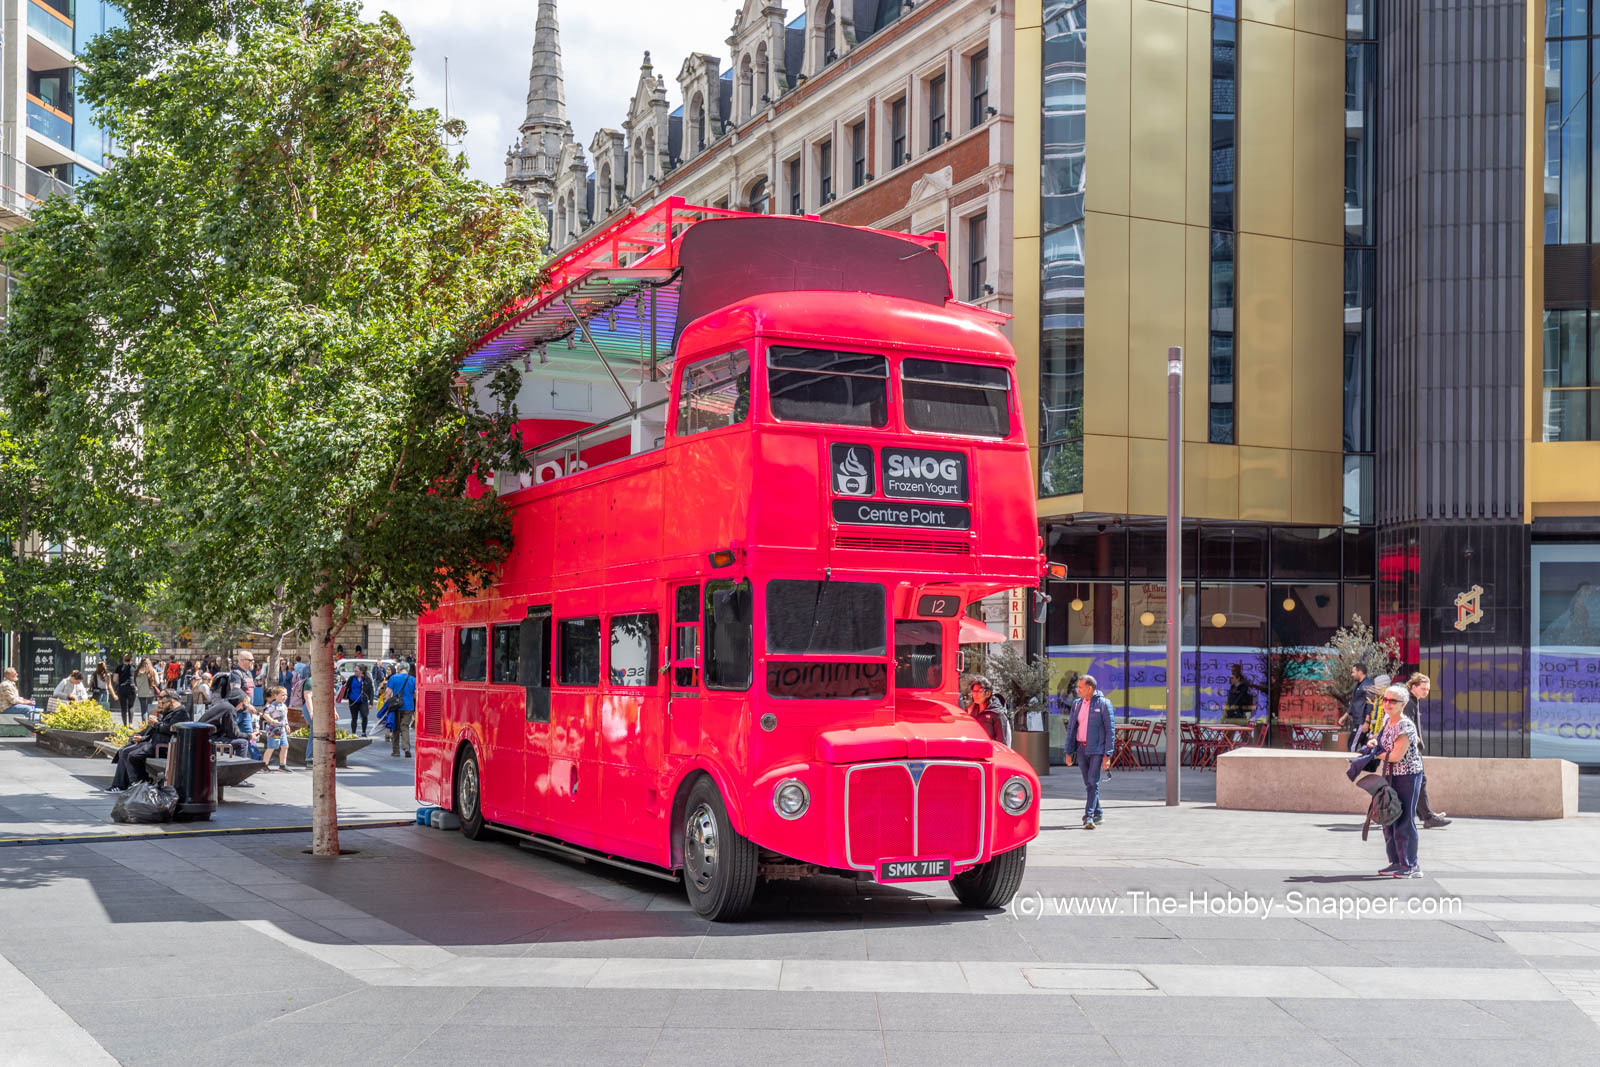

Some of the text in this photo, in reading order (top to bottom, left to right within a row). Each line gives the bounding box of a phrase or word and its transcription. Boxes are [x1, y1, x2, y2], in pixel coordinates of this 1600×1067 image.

[888, 454, 958, 481] SNOG
[889, 480, 959, 496] Frozen Yogurt
[858, 506, 946, 525] Centre Point
[931, 599, 946, 614] 12
[888, 861, 945, 877] SMK 711F
